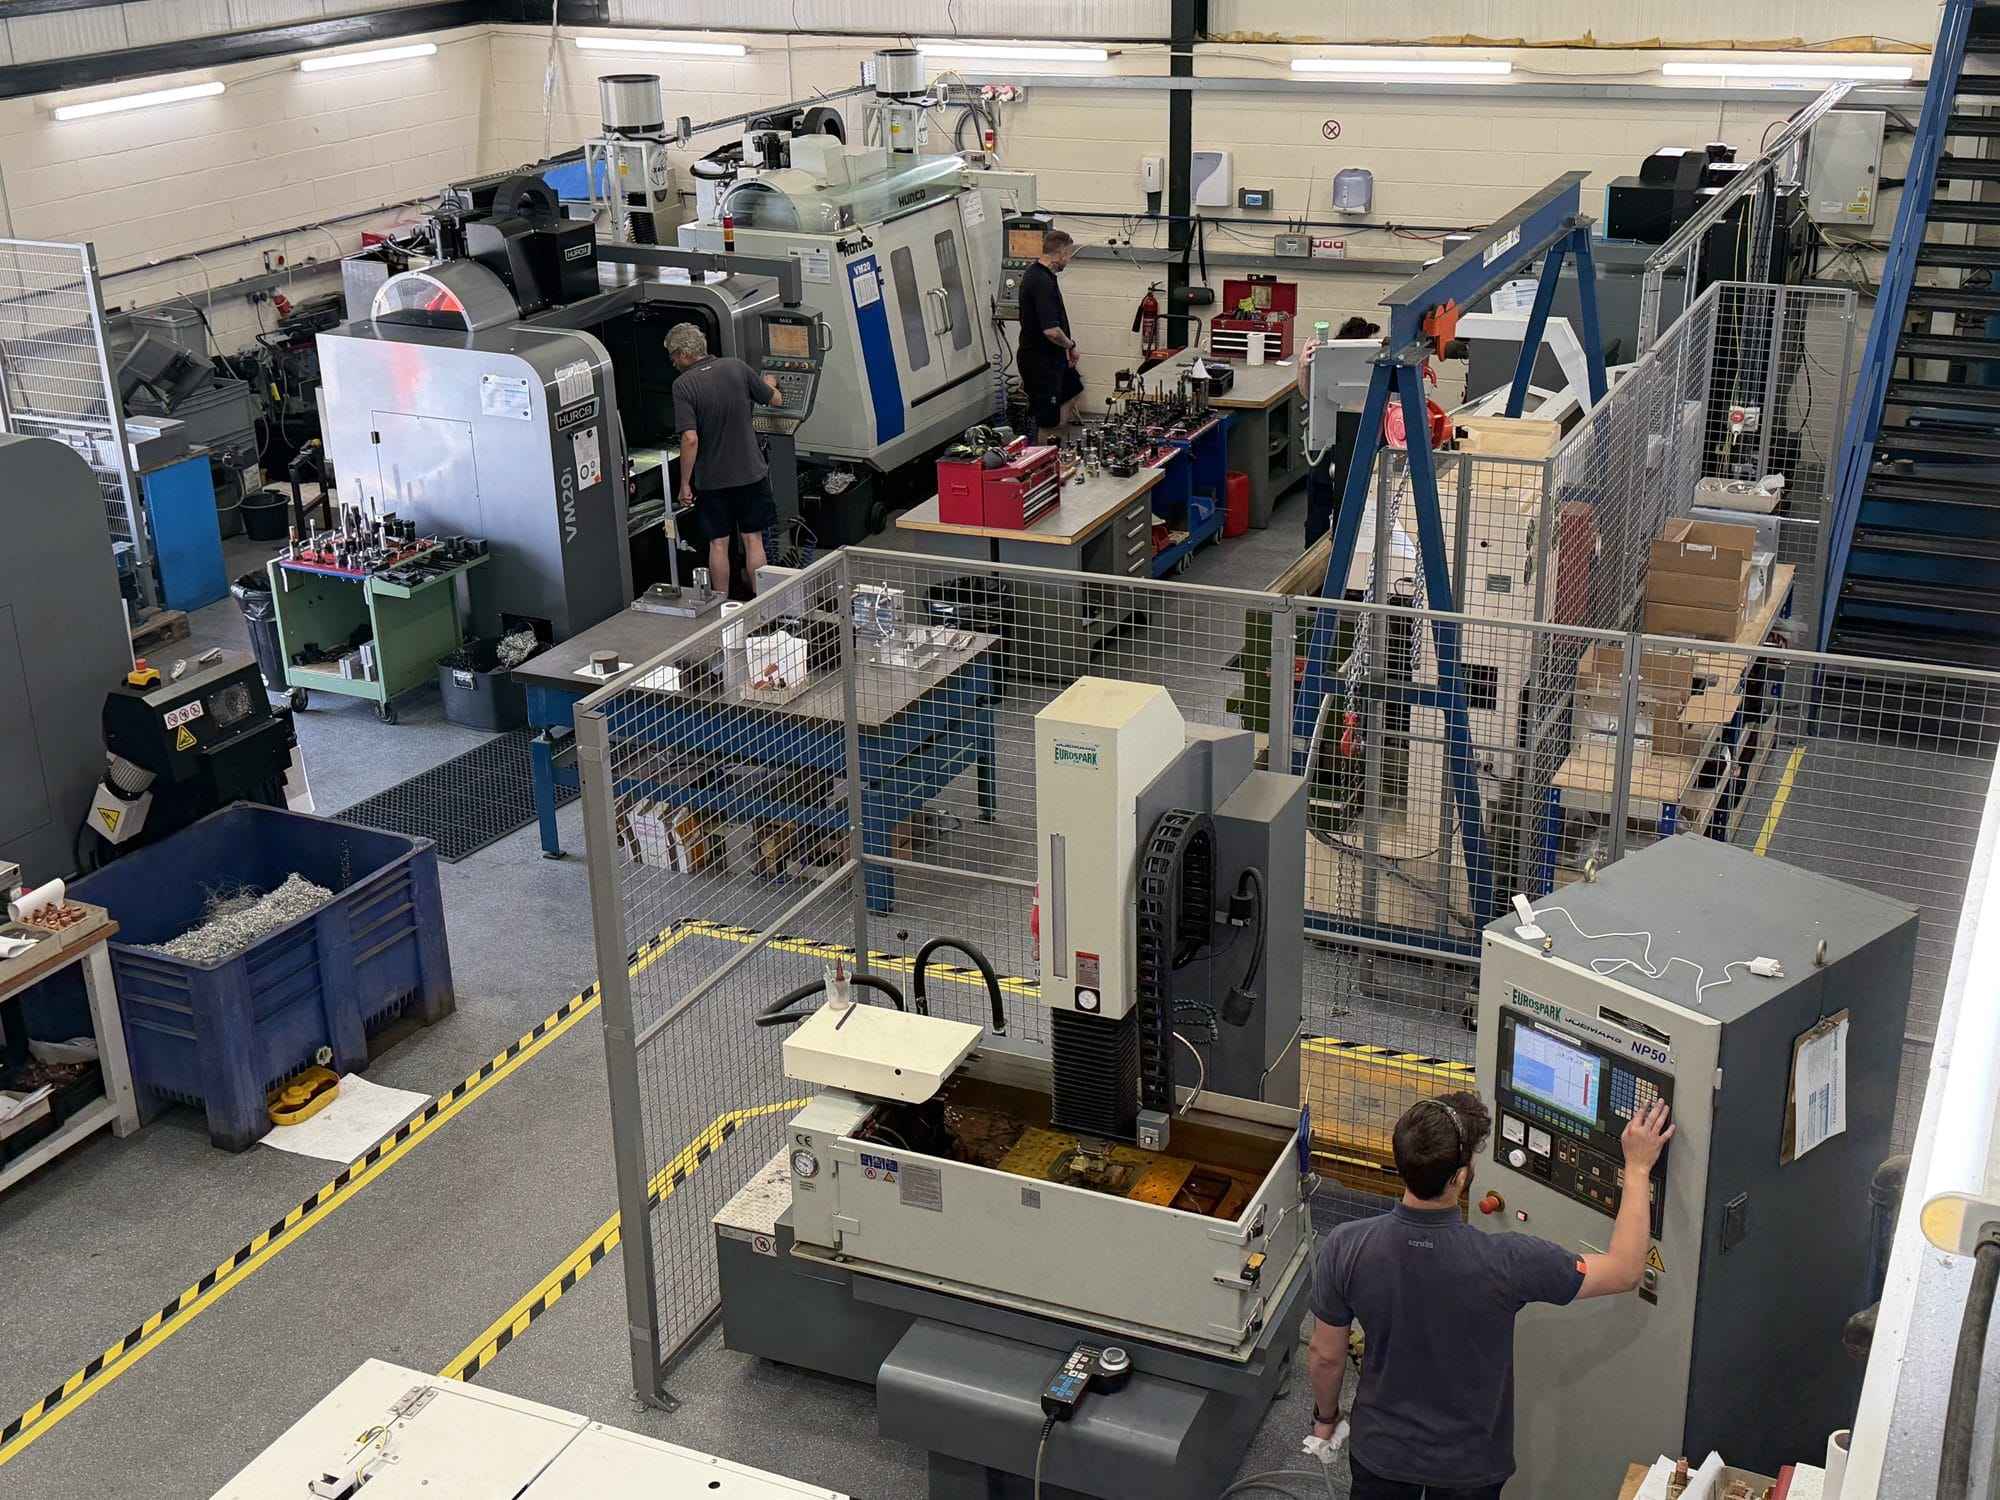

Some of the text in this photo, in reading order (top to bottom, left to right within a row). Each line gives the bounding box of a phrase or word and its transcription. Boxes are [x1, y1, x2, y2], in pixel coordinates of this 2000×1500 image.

[853, 261, 872, 276] VM20
[558, 404, 594, 428] HURCO
[1055, 747, 1097, 767] EUROSPARK
[1512, 988, 1562, 1024] EUROSPARK
[1630, 1040, 1668, 1065] NP50
[795, 1134, 813, 1148] CE
